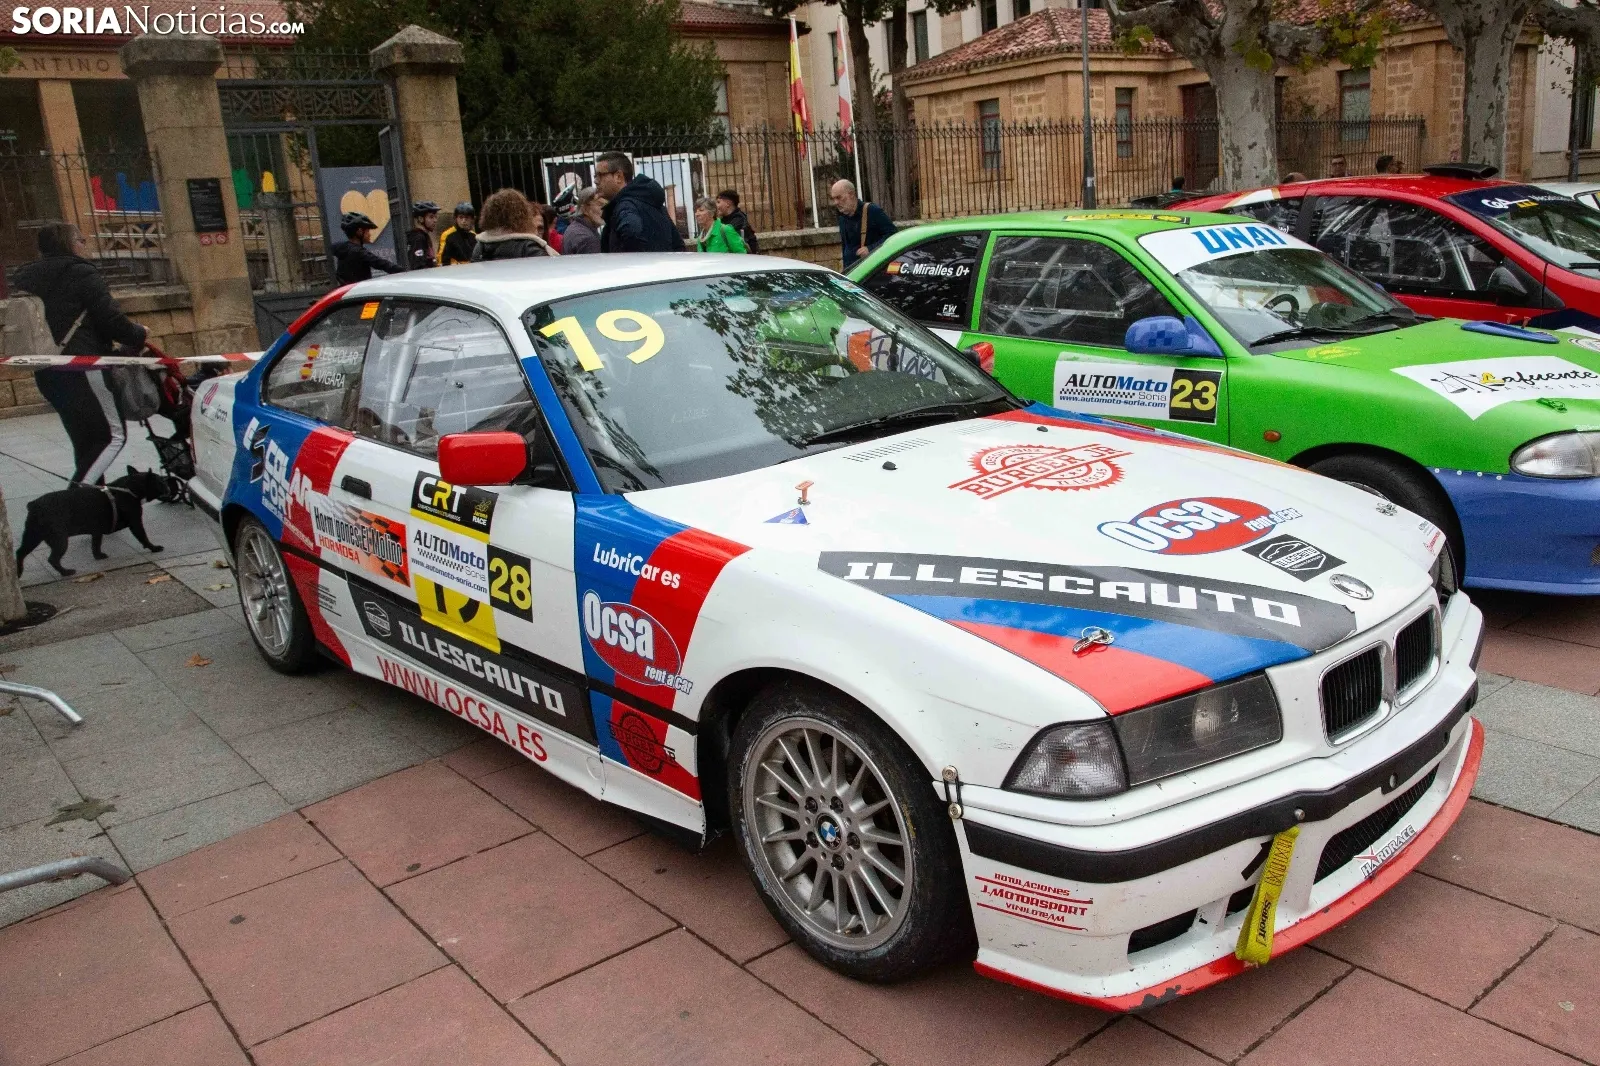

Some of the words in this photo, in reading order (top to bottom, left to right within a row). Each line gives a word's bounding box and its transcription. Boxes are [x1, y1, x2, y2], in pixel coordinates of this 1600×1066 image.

[1191, 226, 1287, 253] UNAI
[913, 263, 953, 276] Miralles
[539, 309, 665, 371] 19
[1059, 395, 1166, 408] www.automoto-soria.com
[1065, 373, 1168, 393] AUTOMoto
[1170, 378, 1217, 411] 23
[1138, 391, 1167, 402] Soria
[959, 454, 1086, 497] BURGER
[418, 476, 467, 513] CRT
[319, 535, 360, 564] HORMOSA
[414, 529, 485, 570] AUTOMoto
[489, 557, 532, 610] 28
[844, 562, 1301, 627] ILLESCAUTO
[398, 620, 567, 717] ILLESCAUTO
[645, 665, 666, 684] rent
[673, 673, 694, 695] car
[376, 655, 548, 762] WWW.OCSA.ES
[1360, 824, 1417, 878] HARDRACE
[980, 885, 1088, 917] J.MOTORSPORT
